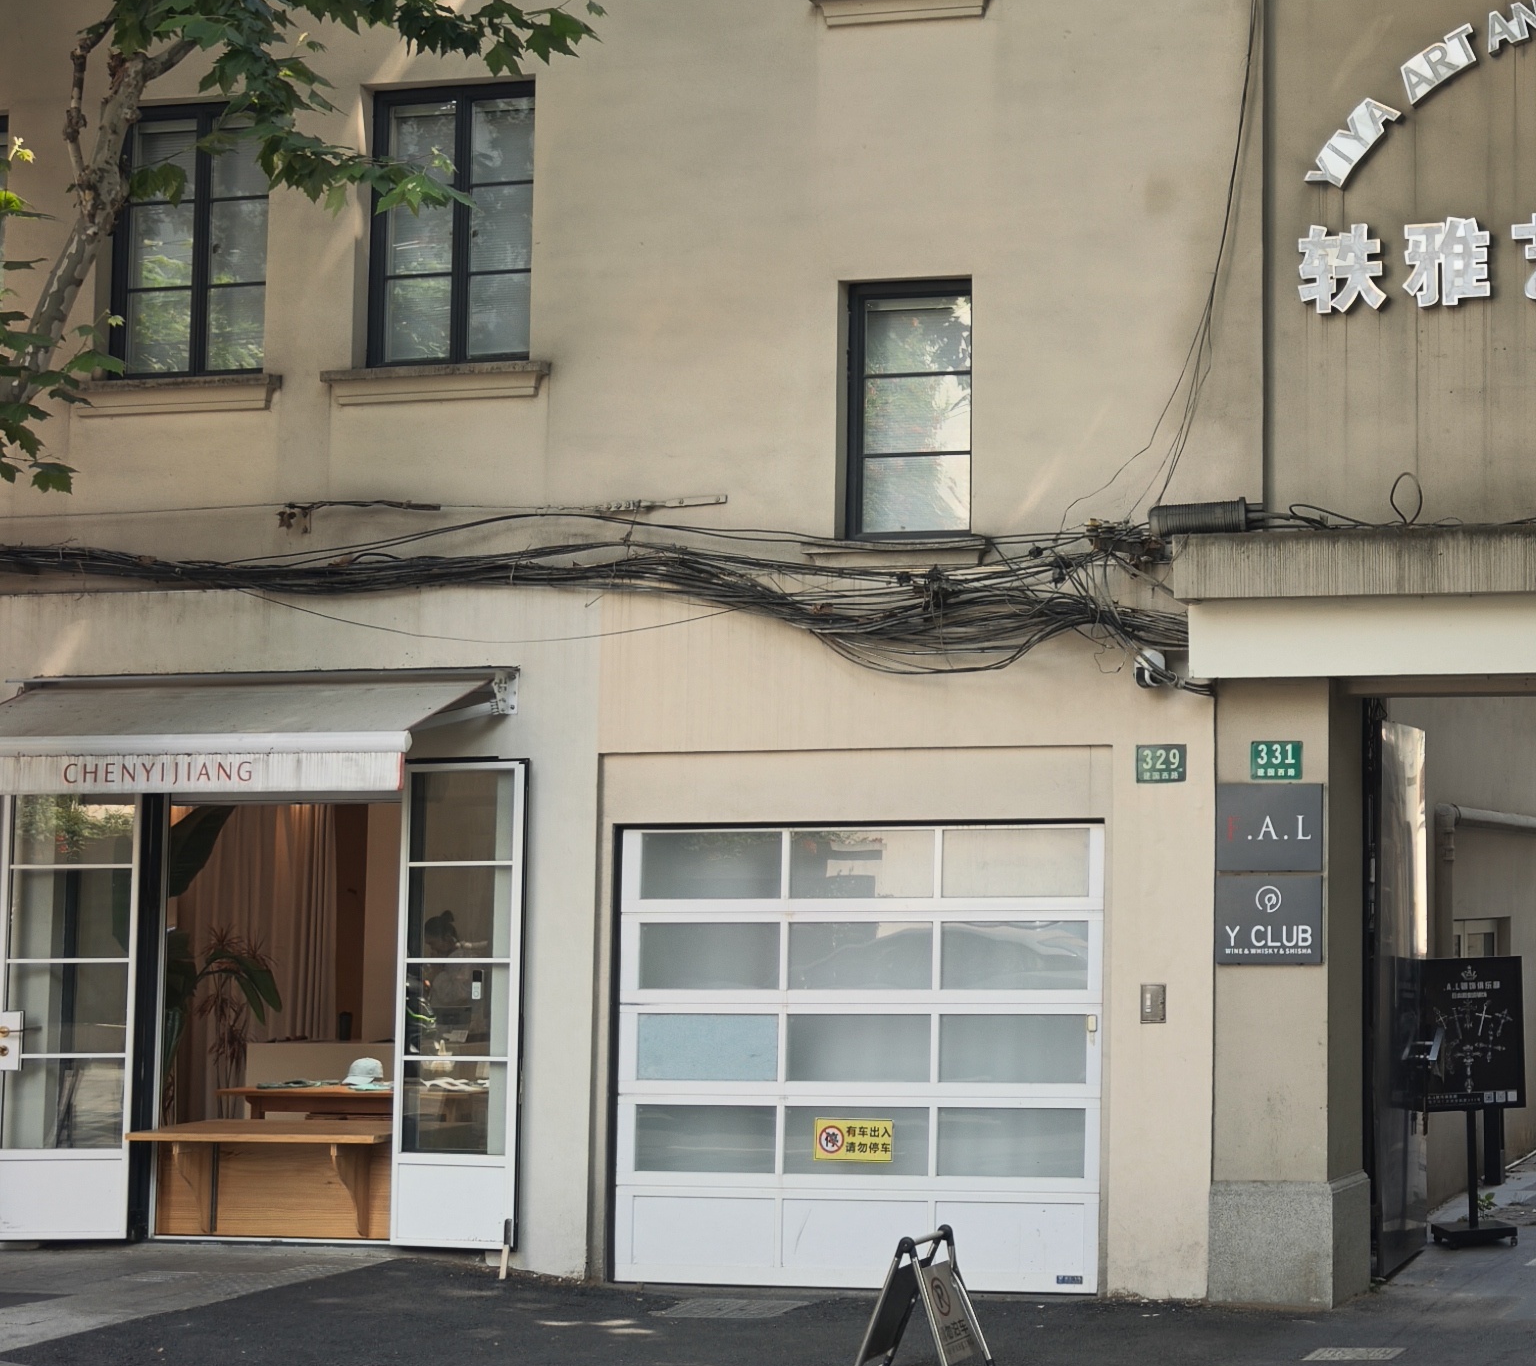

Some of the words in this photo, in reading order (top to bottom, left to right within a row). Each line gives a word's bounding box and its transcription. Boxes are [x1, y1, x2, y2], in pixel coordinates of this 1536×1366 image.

[1304, 97, 1402, 189] YIYA
[1400, 23, 1477, 107] ART
[1142, 748, 1180, 769] 329
[1257, 744, 1296, 765] 331
[63, 761, 252, 785] CHENYIJIANG
[1257, 768, 1295, 777] 建国西路
[1225, 925, 1240, 947] Y
[1251, 925, 1312, 947] CLUB
[846, 1126, 892, 1138] 有车出入
[845, 1142, 892, 1154] 请勿停车
